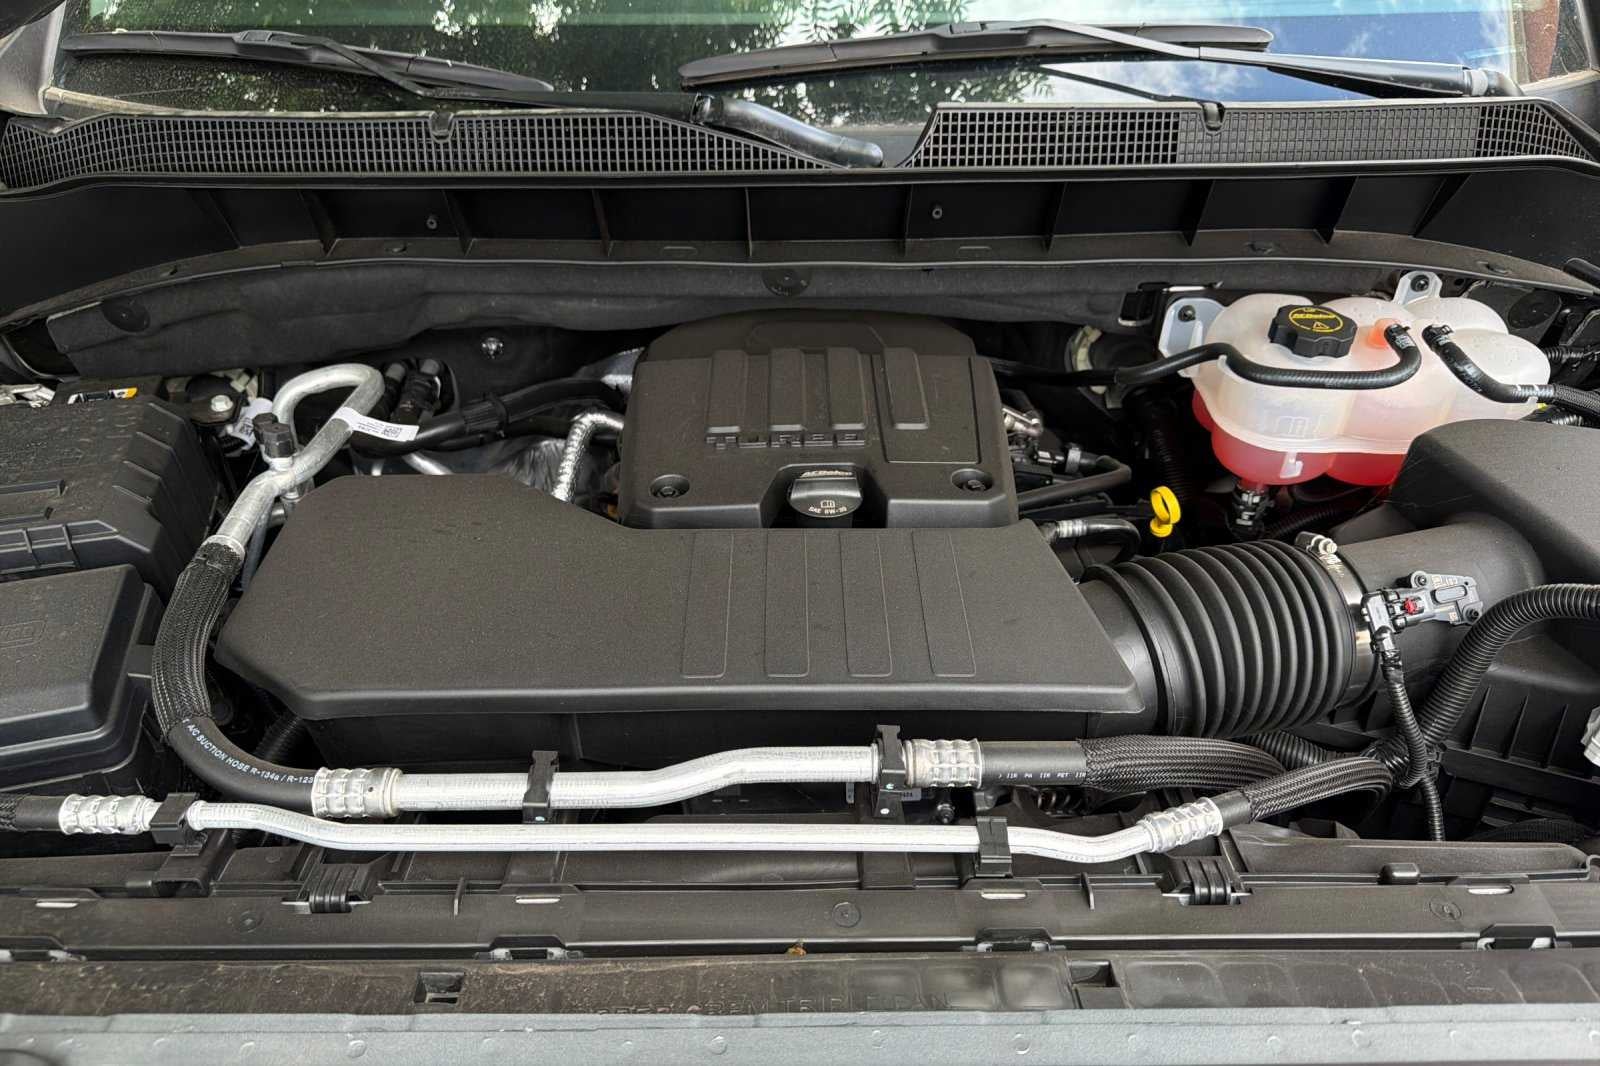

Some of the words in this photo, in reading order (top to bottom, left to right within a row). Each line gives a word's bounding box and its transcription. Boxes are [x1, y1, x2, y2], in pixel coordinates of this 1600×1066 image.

[197, 735, 226, 760] SUCTION
[225, 757, 250, 773] HOSE
[249, 766, 280, 781] R-134a
